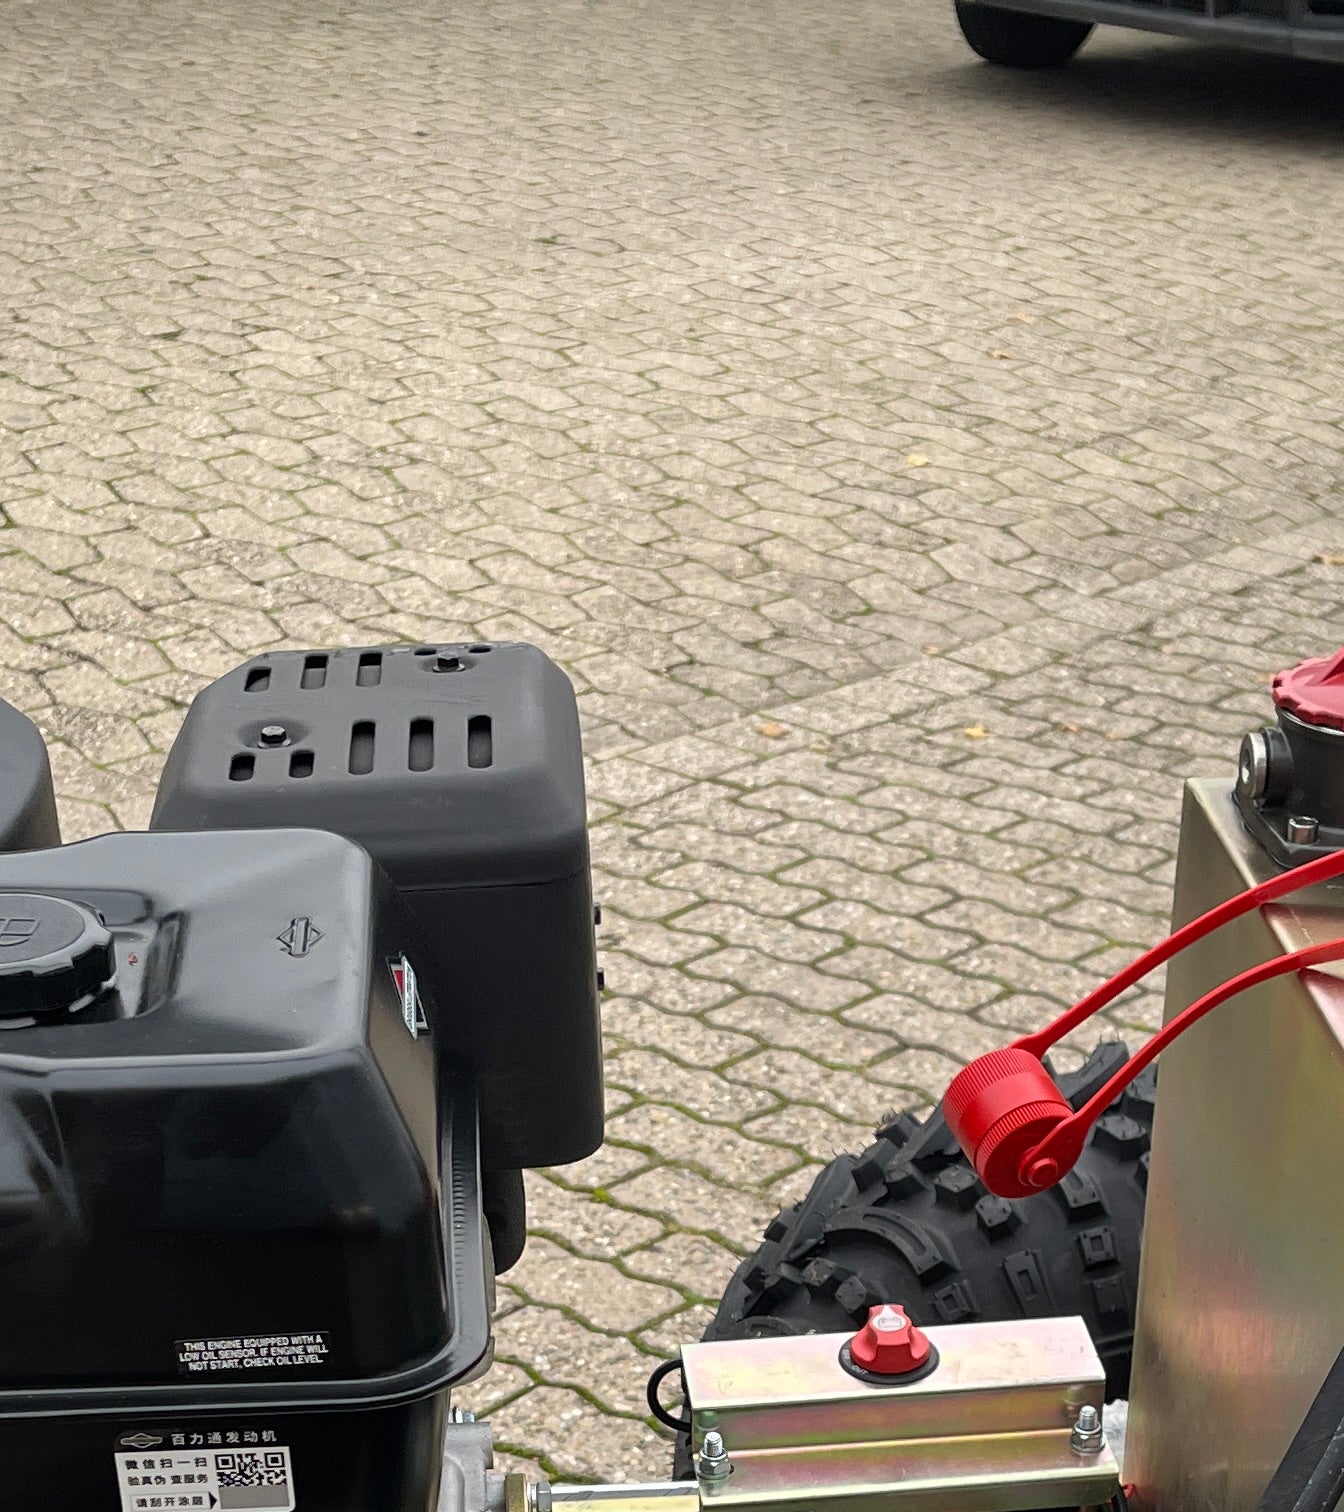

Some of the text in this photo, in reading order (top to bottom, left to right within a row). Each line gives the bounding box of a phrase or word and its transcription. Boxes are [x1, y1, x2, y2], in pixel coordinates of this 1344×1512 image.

[184, 1335, 322, 1351] THIS ENGINE EQUIPPED WITH A
[179, 1352, 199, 1362] LOW
[201, 1351, 217, 1360] OIL
[260, 1348, 268, 1357] IF
[271, 1346, 305, 1356] ENGINE
[307, 1344, 329, 1354] WILL
[188, 1362, 208, 1371] NOT
[243, 1357, 275, 1367] CHECK
[276, 1356, 292, 1365] OIL
[171, 1430, 277, 1446] 百力通发动机
[125, 1457, 207, 1470] 微信扫一扫
